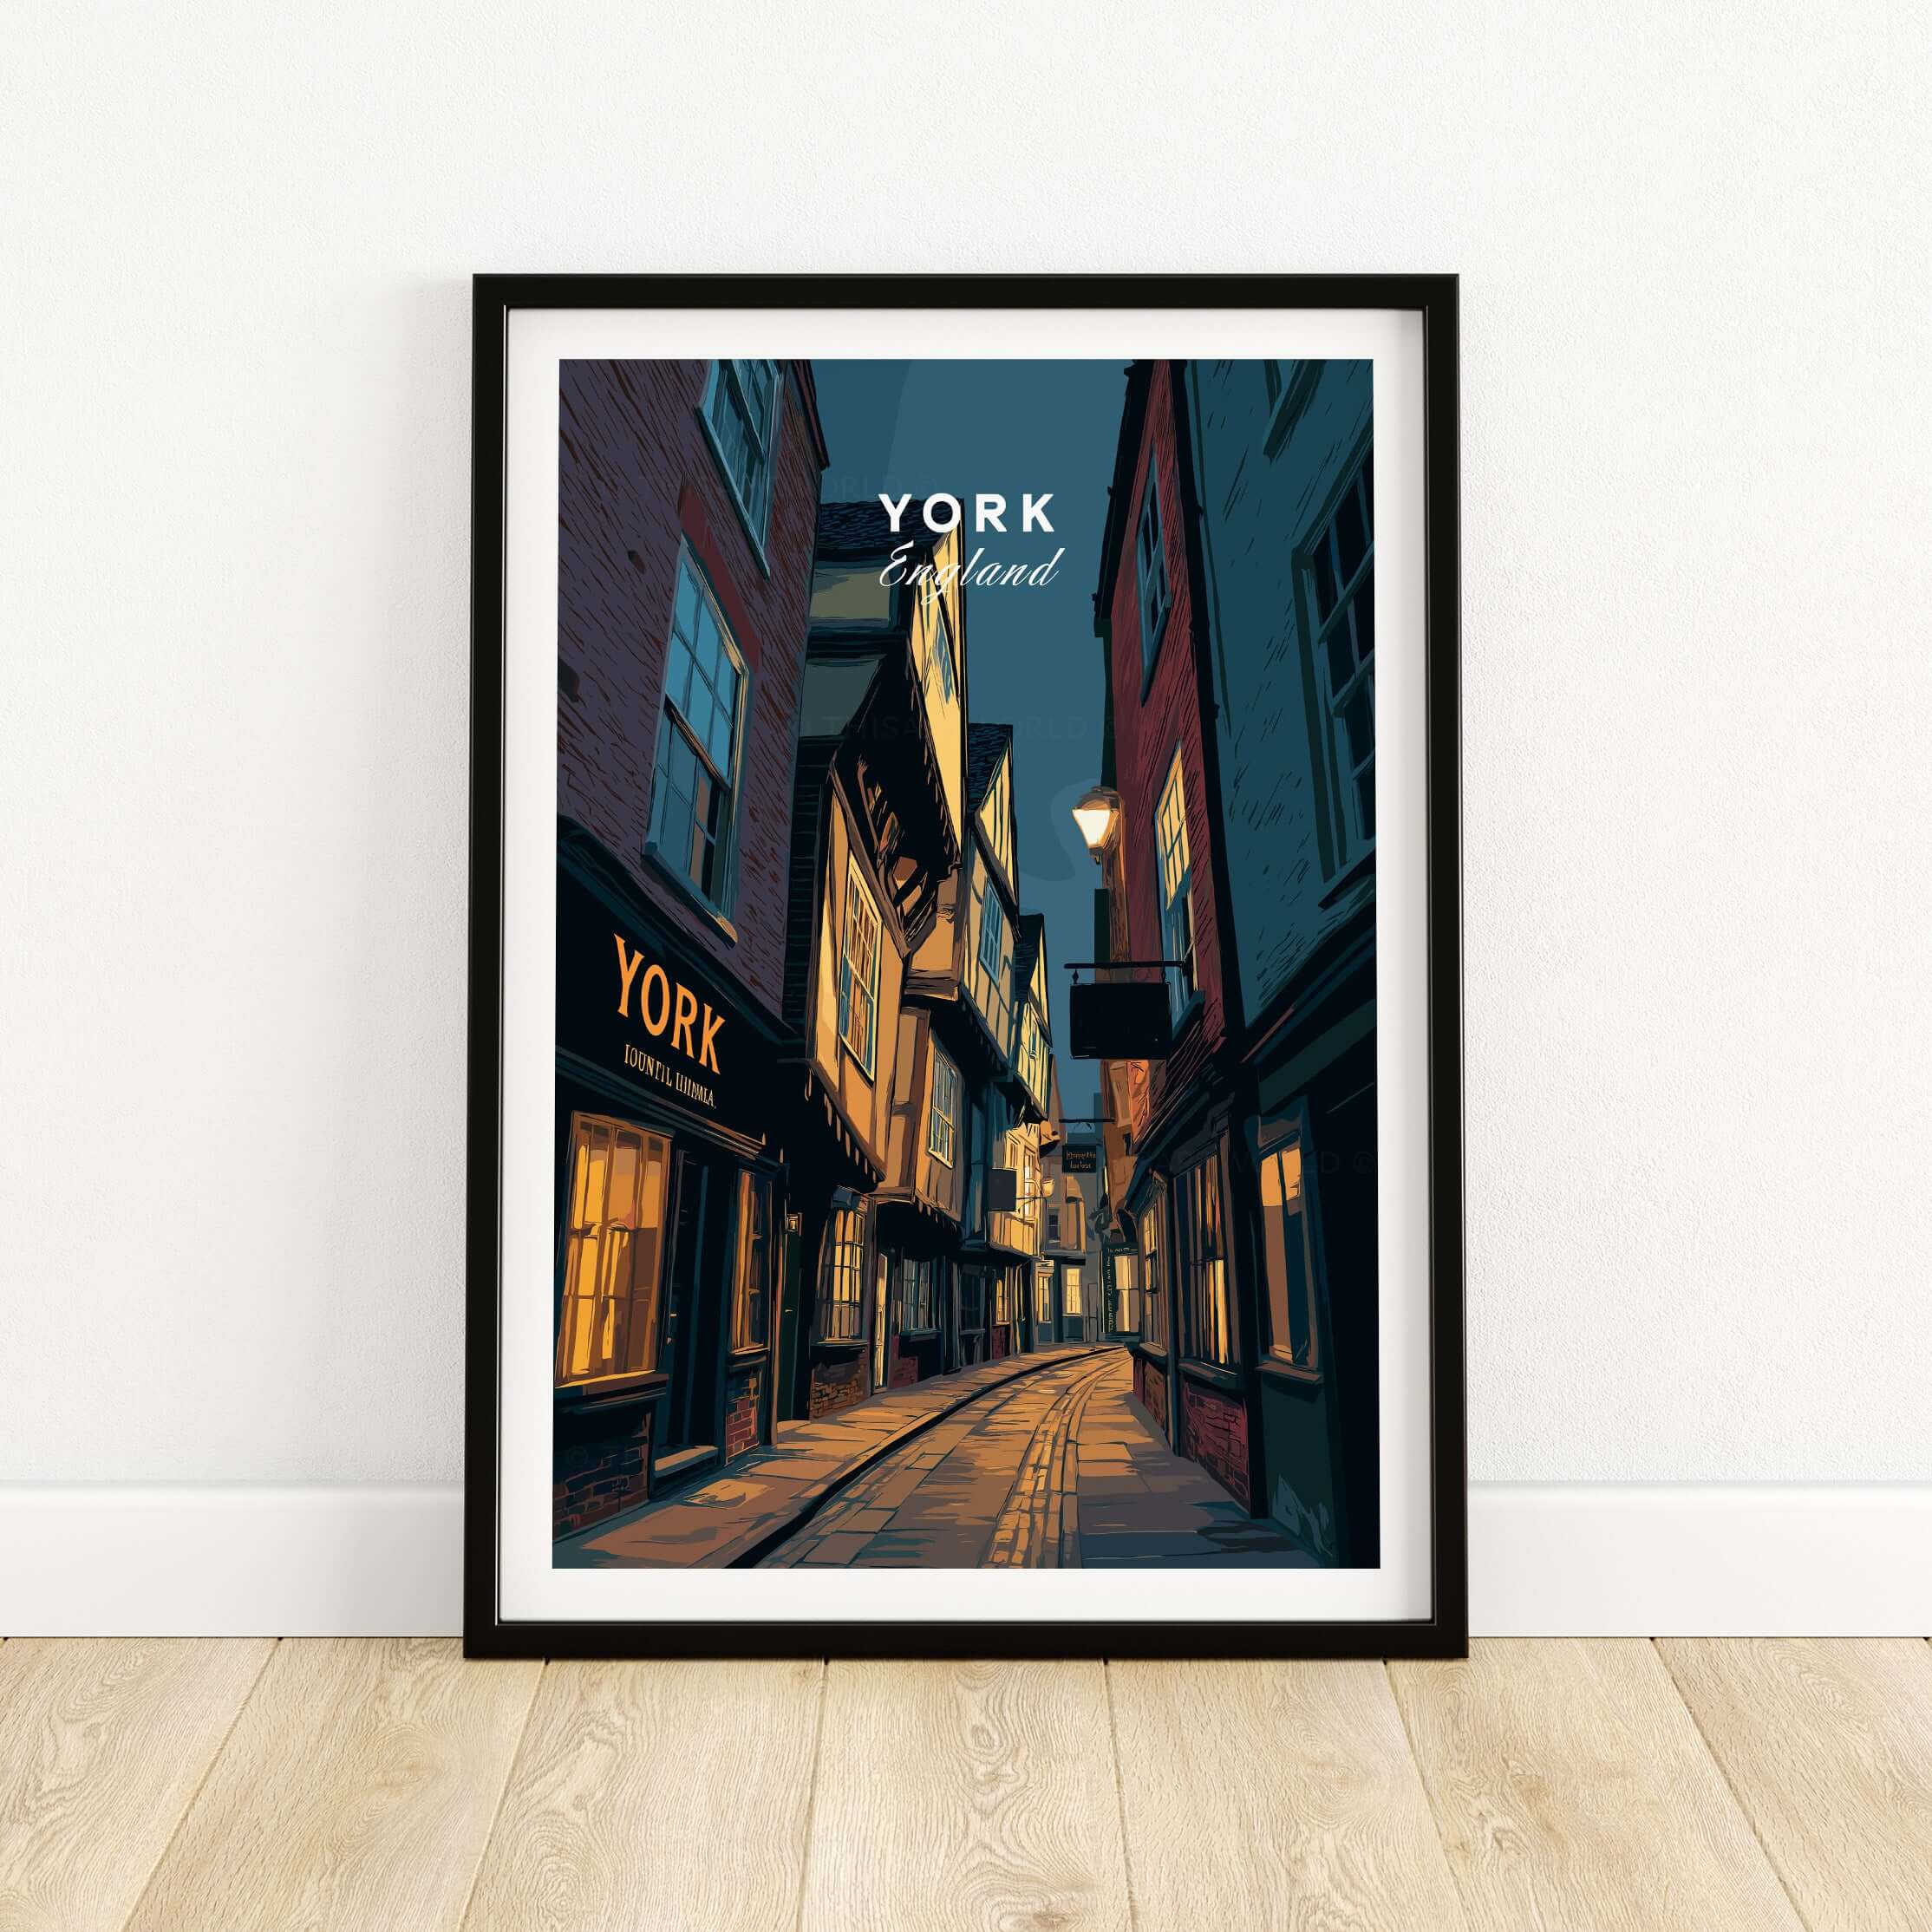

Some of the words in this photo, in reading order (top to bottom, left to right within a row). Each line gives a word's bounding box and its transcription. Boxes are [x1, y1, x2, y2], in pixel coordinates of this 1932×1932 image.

[878, 493, 1054, 533] YORK
[878, 539, 1066, 606] England
[613, 932, 727, 1075] YORK
